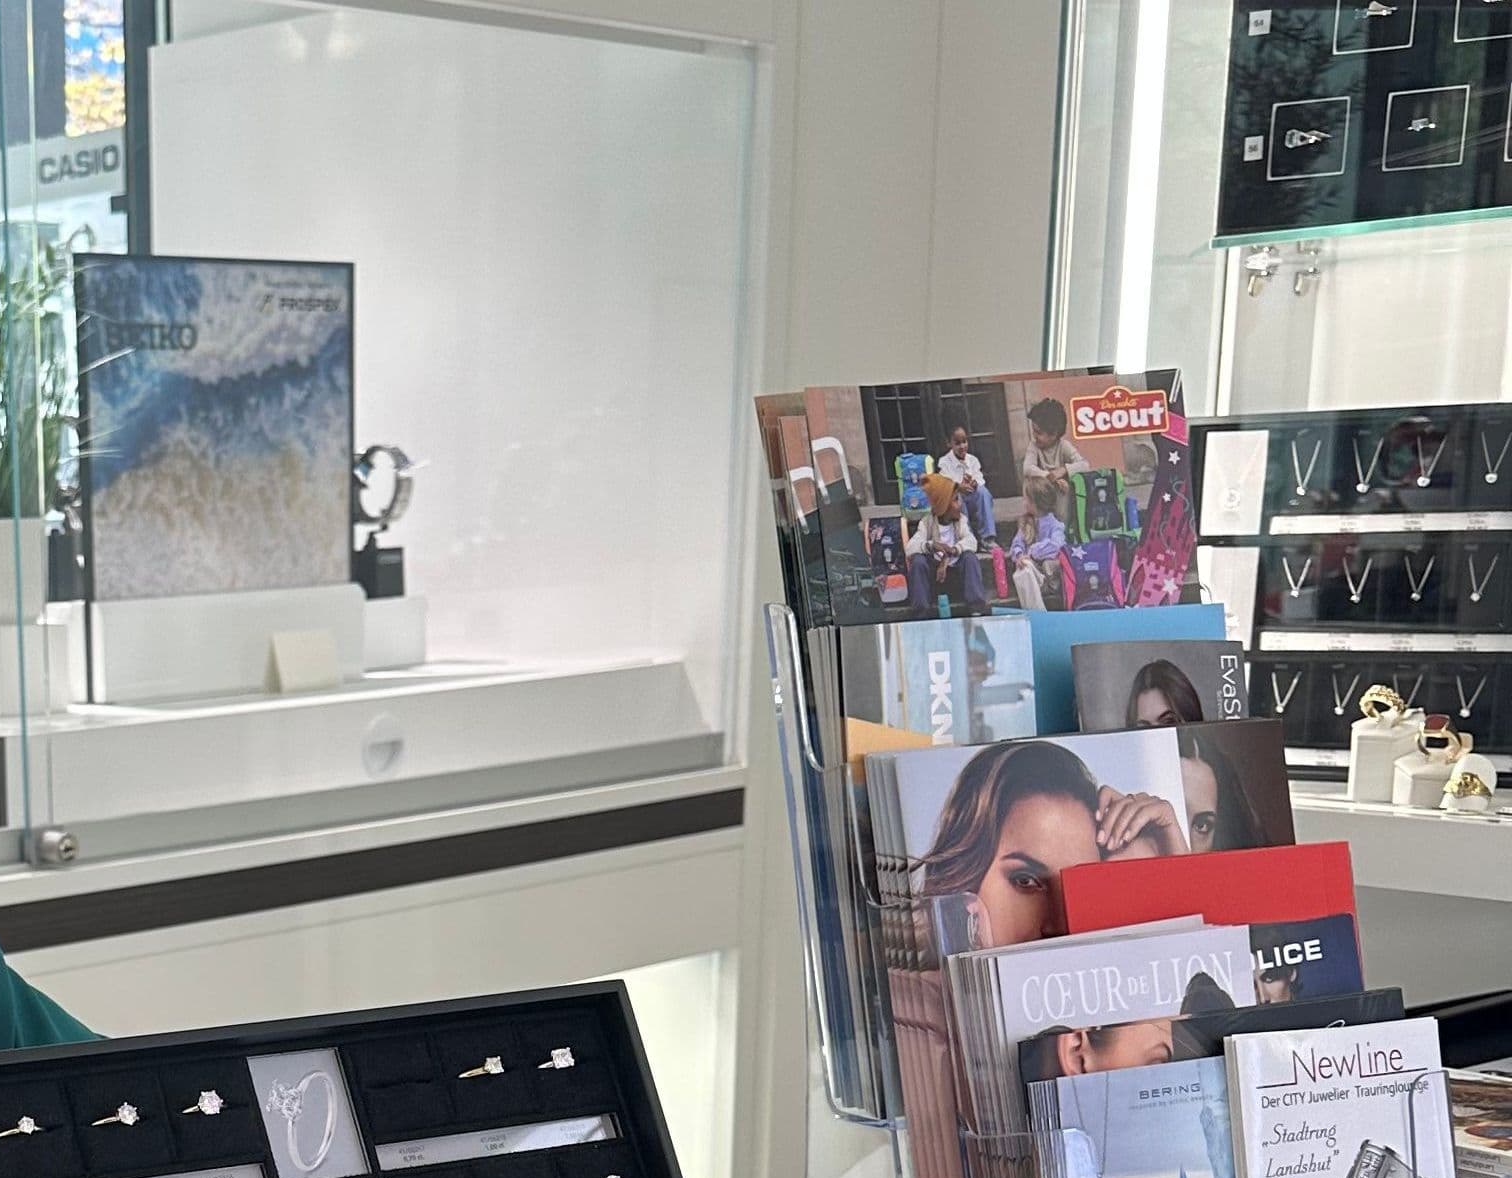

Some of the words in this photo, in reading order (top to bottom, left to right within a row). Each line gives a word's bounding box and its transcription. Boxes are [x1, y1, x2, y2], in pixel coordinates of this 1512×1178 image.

[39, 144, 120, 184] CASIO
[105, 321, 199, 351] SEIKO
[1075, 400, 1165, 434] Scout
[1250, 938, 1324, 971] LICE
[1292, 1041, 1405, 1084] NewLine
[1138, 1083, 1201, 1100] BERING
[1261, 1095, 1281, 1109] Der
[1282, 1091, 1306, 1106] CITY
[1307, 1088, 1350, 1105] Juwelier
